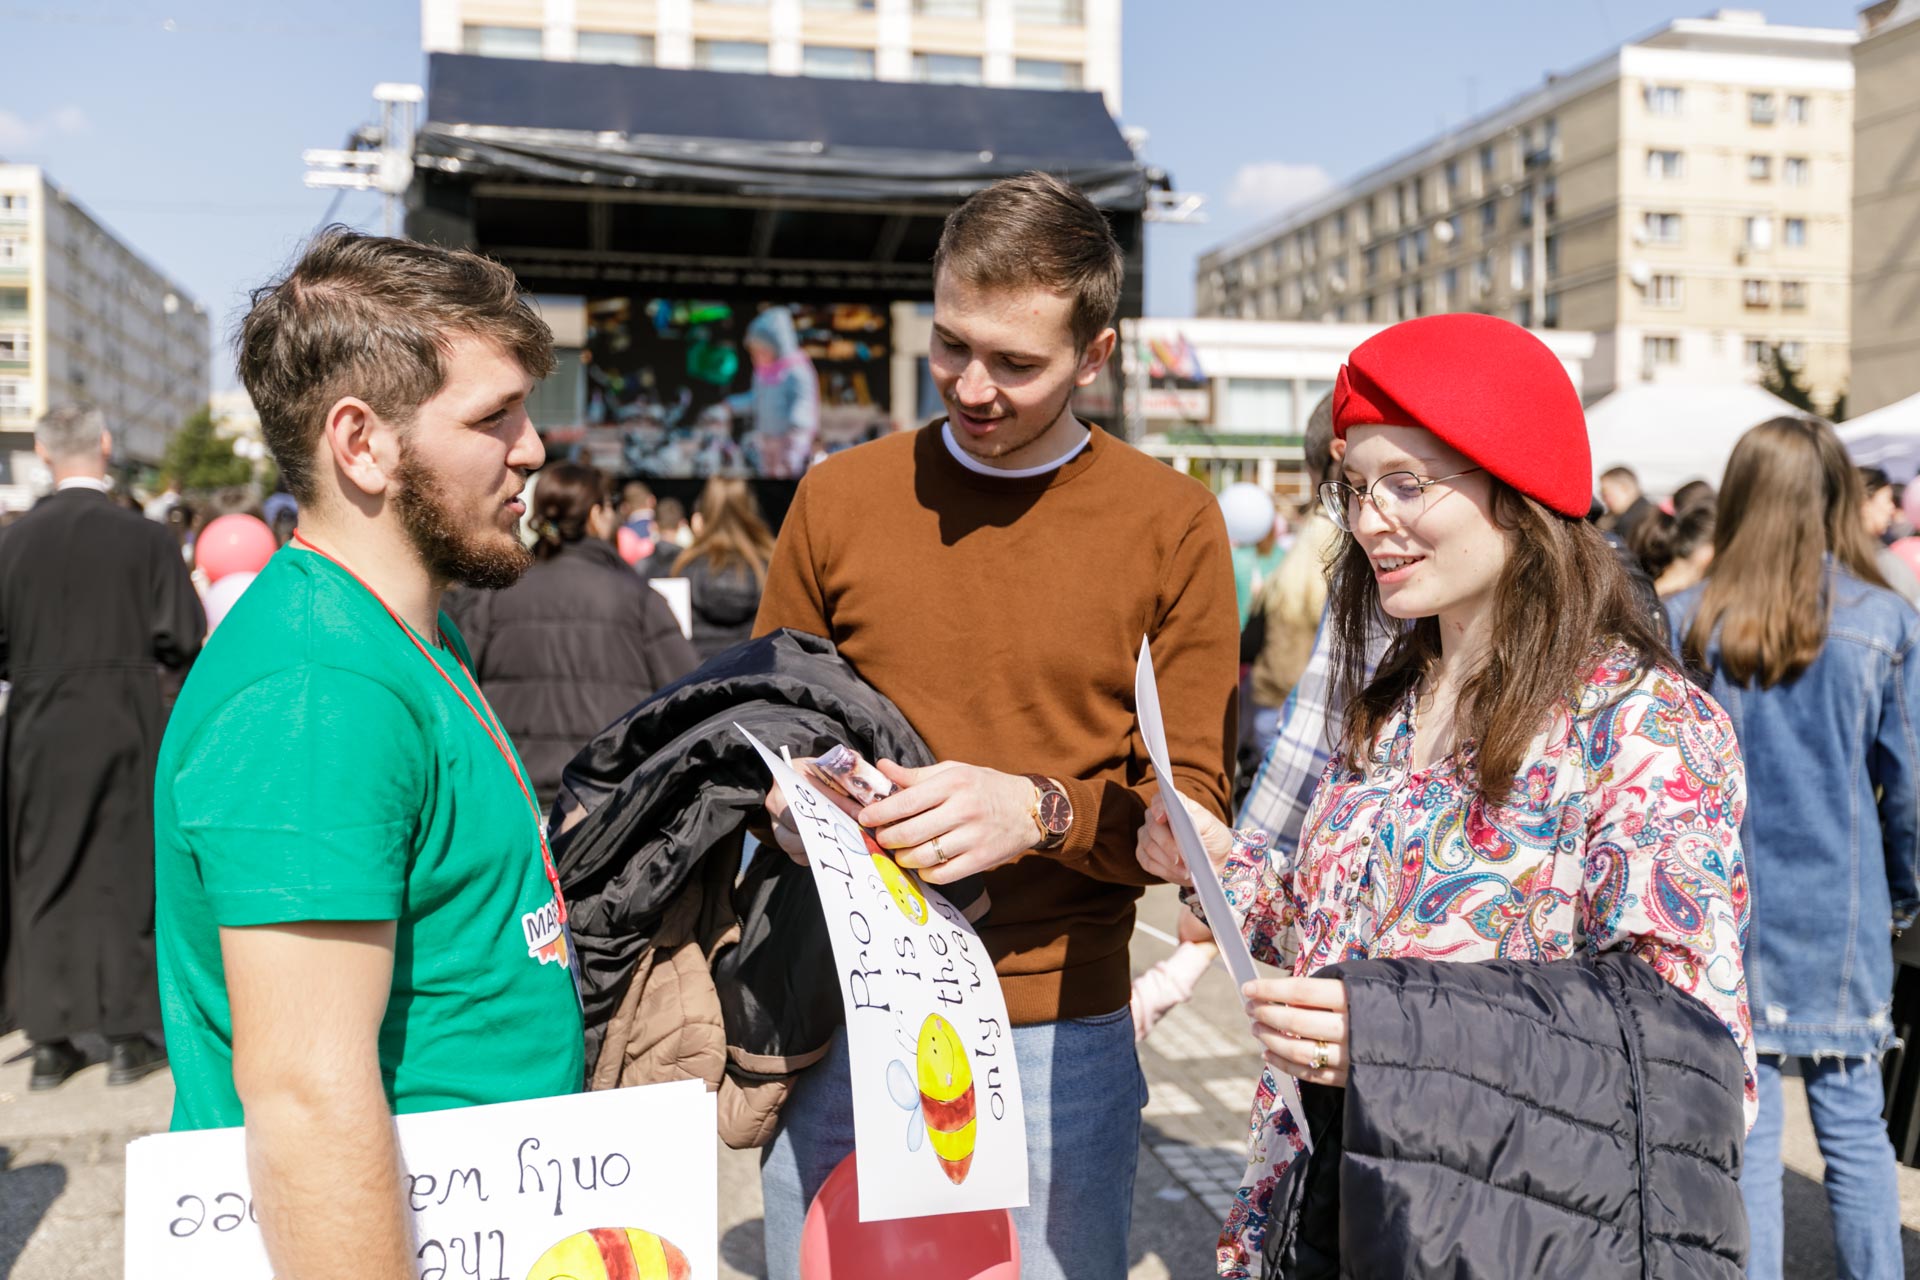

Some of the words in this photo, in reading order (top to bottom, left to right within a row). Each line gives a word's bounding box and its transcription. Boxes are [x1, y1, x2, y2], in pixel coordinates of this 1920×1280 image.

[795, 784, 892, 1013] Pro-Life
[895, 935, 924, 981] is
[928, 932, 963, 1008] the
[936, 901, 981, 993] way
[975, 1017, 1005, 1122] only
[169, 1191, 260, 1238] ee
[404, 1167, 489, 1212] wa
[517, 1137, 631, 1216] only
[416, 1229, 510, 1280] the
